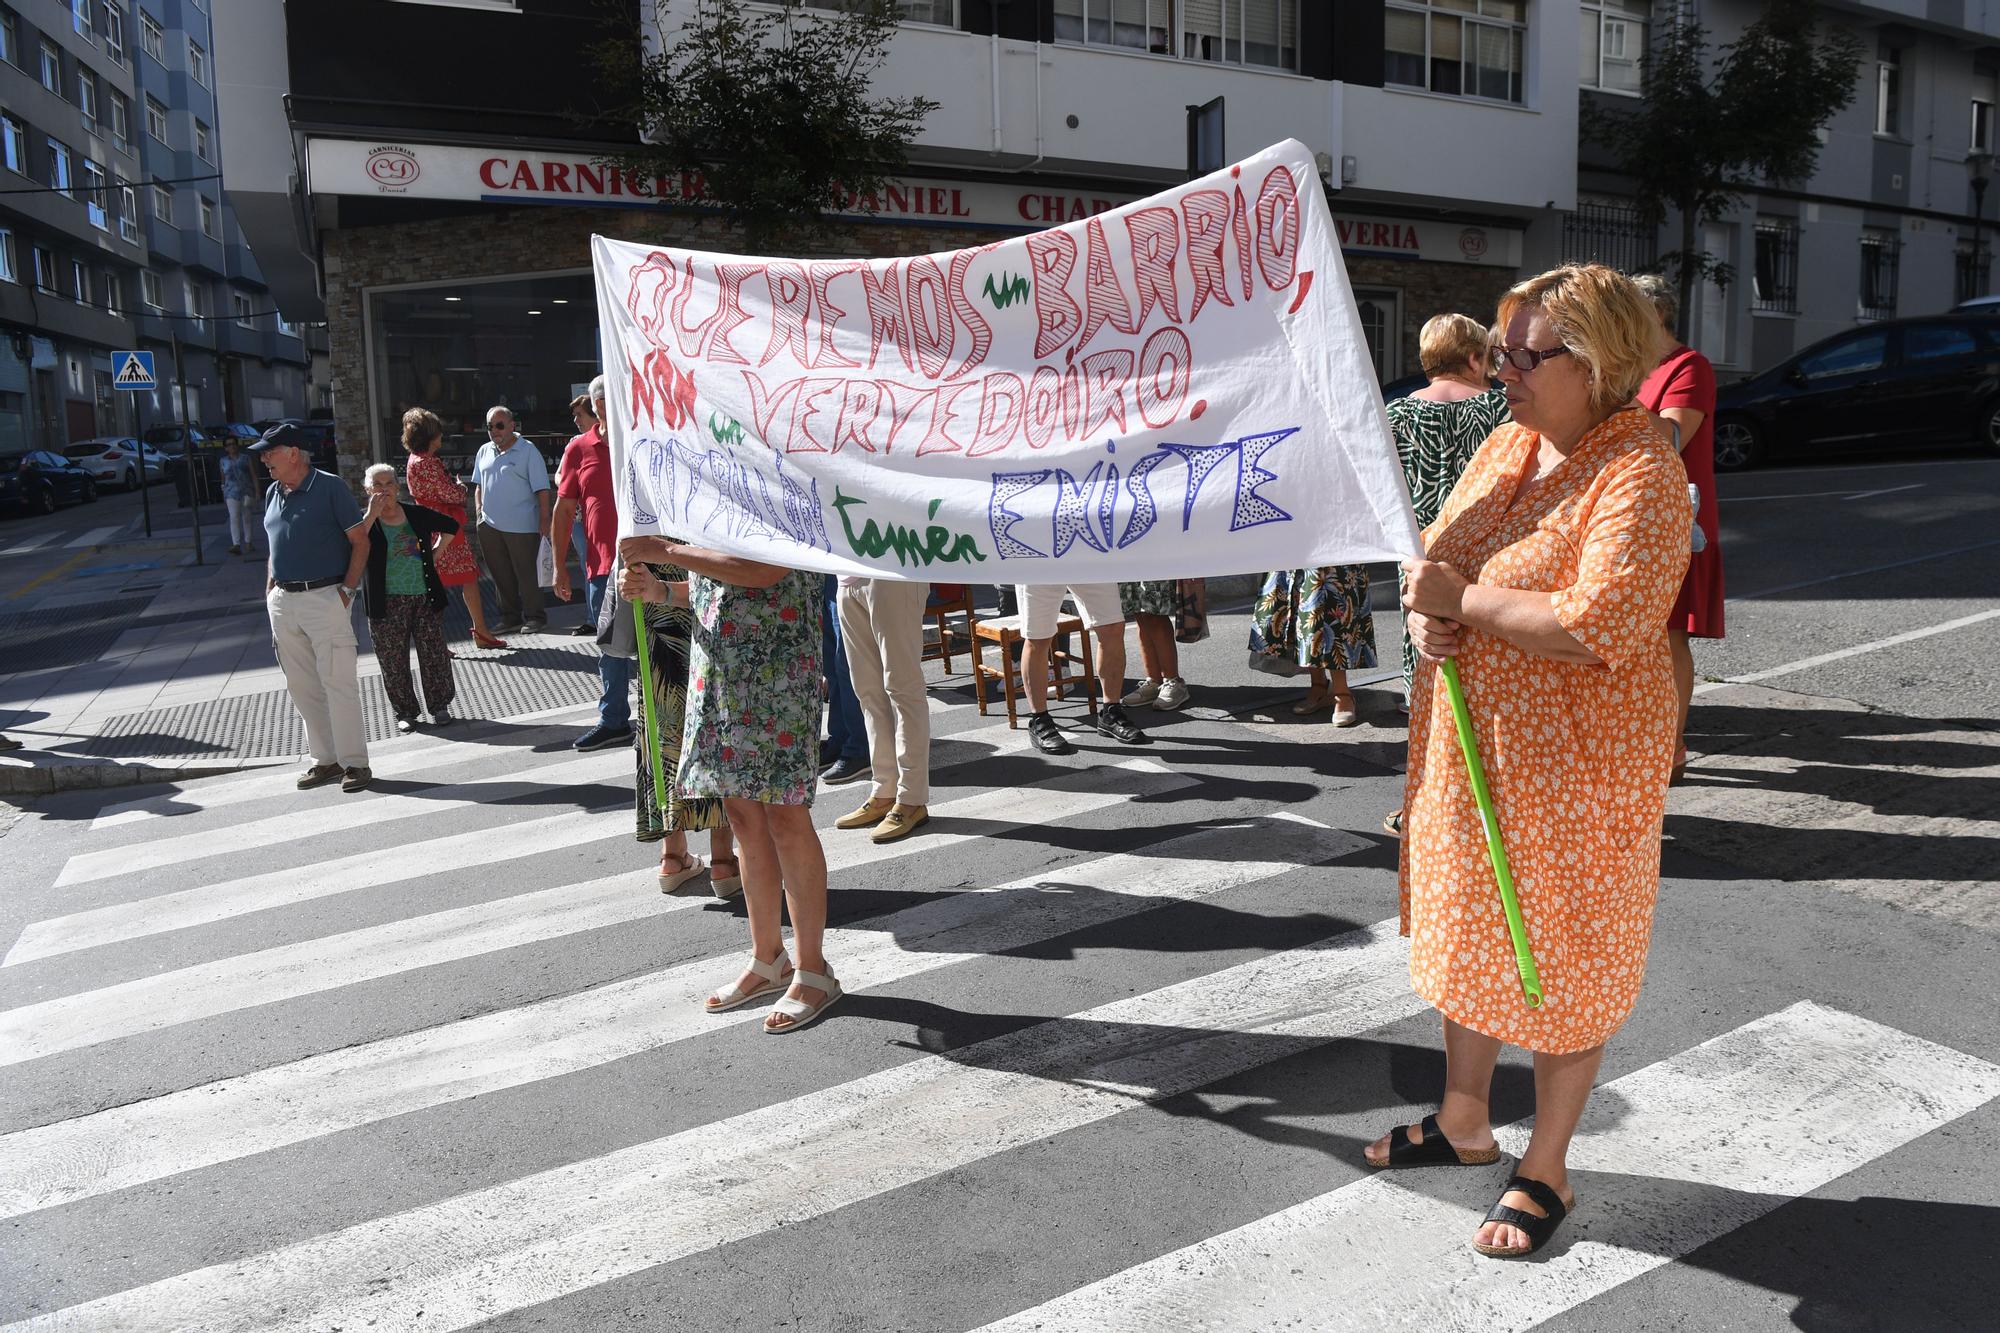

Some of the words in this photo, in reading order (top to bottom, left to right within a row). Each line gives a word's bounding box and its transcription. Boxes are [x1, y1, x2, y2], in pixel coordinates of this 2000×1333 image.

[479, 158, 719, 200] CARNICER
[1335, 219, 1420, 250] VERIA
[627, 241, 1005, 382] QUEREMOS
[982, 270, 1031, 310] un
[627, 343, 700, 432] NON
[832, 485, 988, 568] tamén
